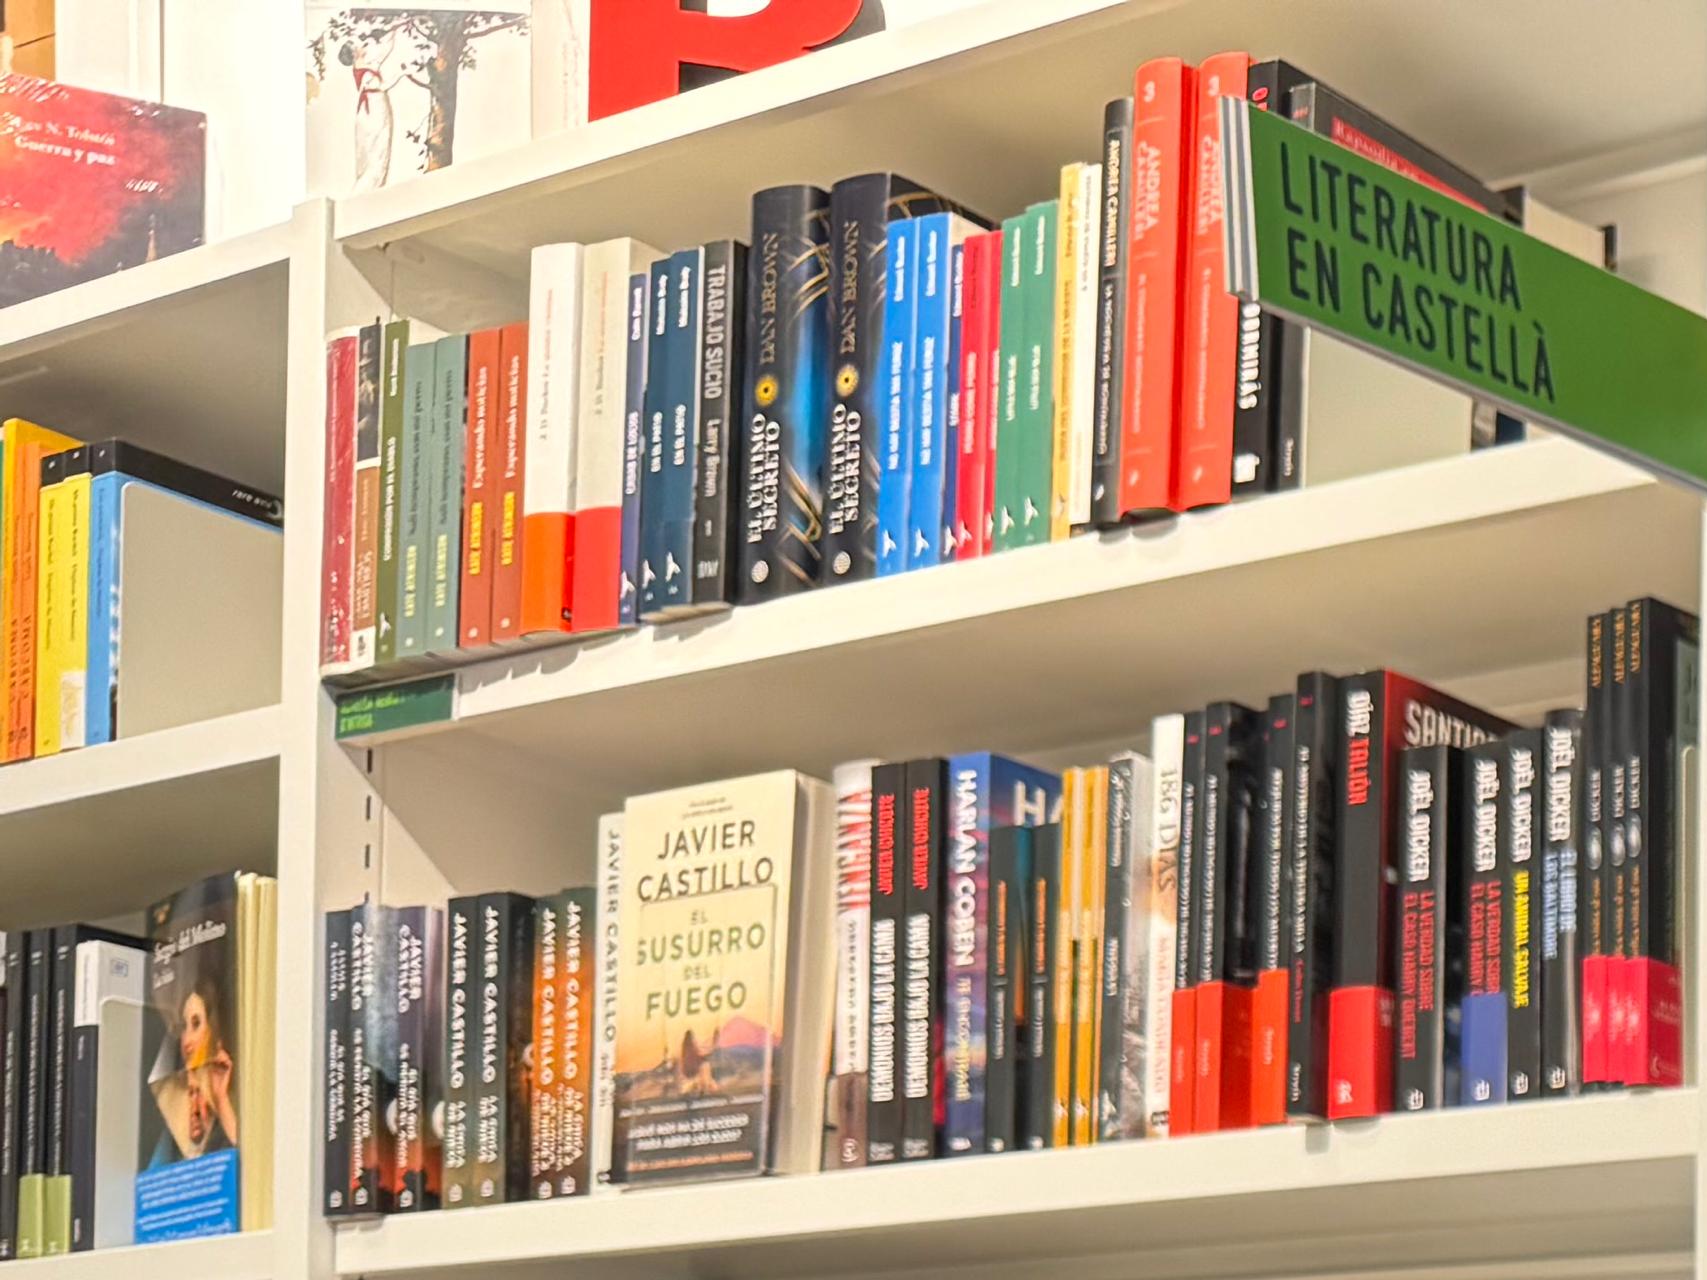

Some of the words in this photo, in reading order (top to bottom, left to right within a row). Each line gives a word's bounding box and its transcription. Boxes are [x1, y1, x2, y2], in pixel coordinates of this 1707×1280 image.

[1281, 142, 1522, 310] LITERATURA
[705, 265, 726, 343] TRABAJO
[1287, 226, 1341, 313] EN
[1362, 262, 1555, 403] CASTELLÀ
[704, 346, 724, 399] SUCIO
[1408, 770, 1433, 825] JOËL
[658, 819, 755, 859] JAVIER
[1408, 827, 1431, 883] DICKER
[637, 857, 774, 903] CASTILLO
[636, 923, 766, 965] SUSURRO
[684, 963, 712, 980] DEL
[646, 981, 747, 1022] FUEGO
